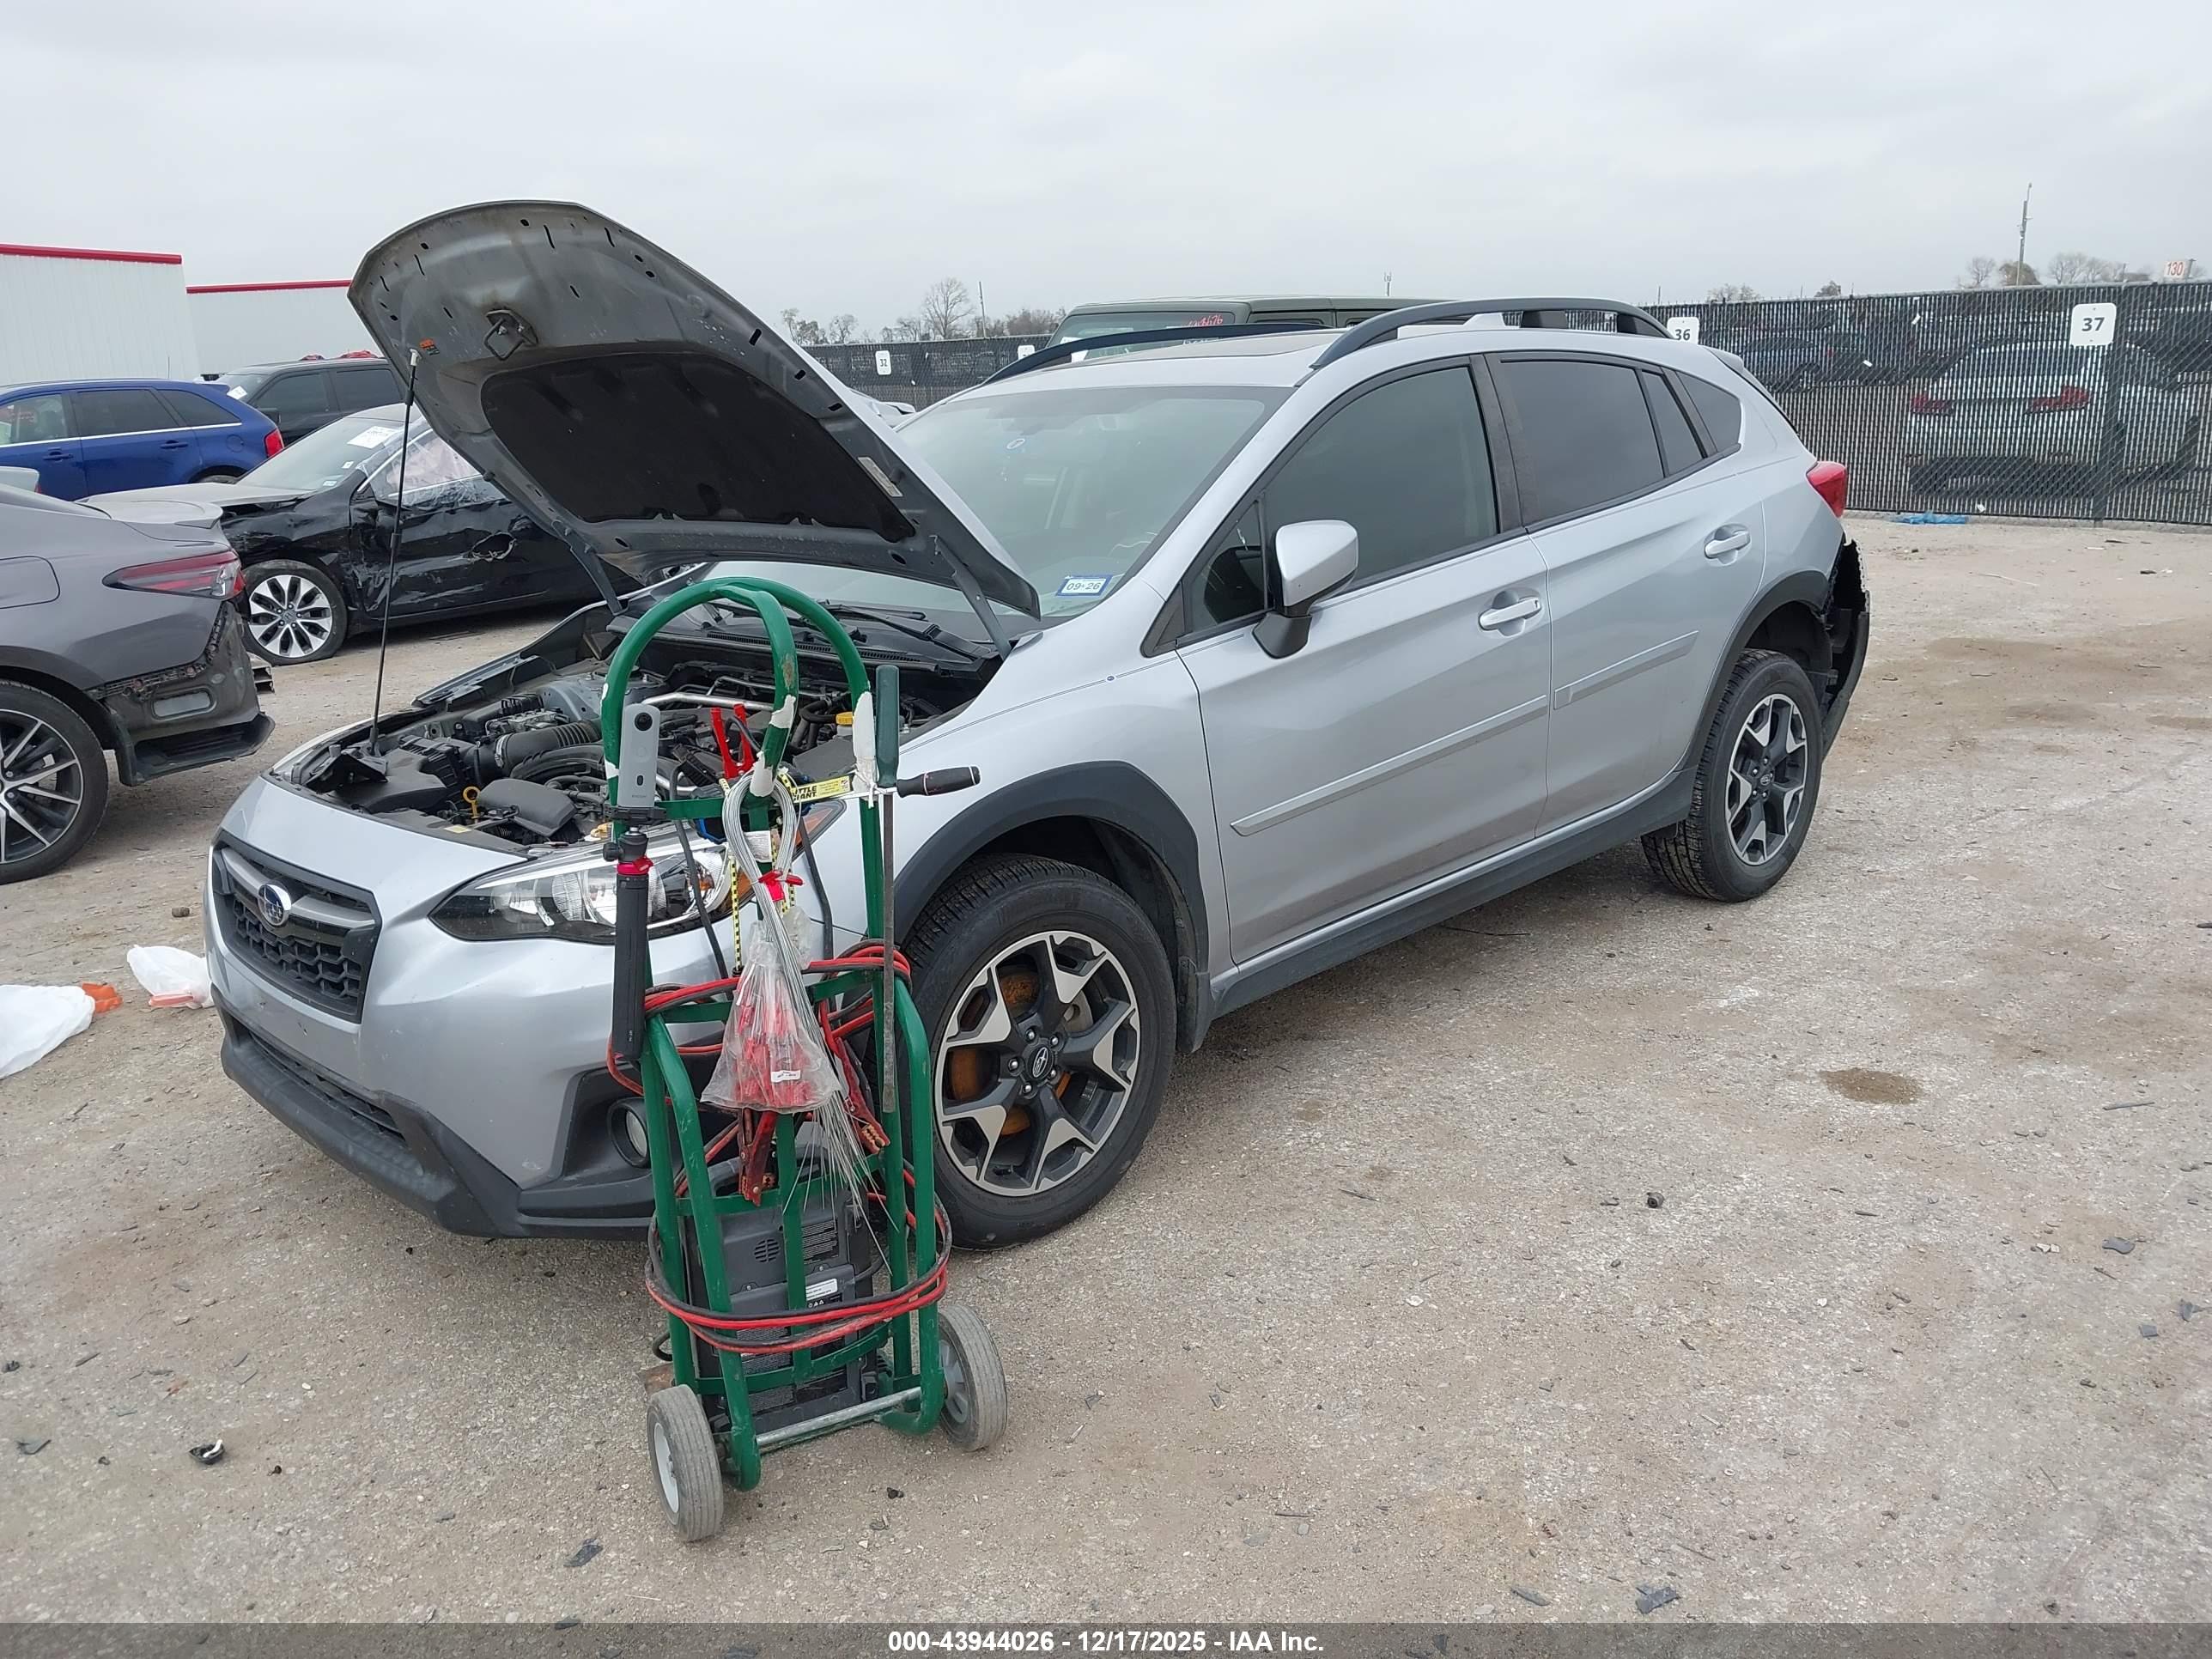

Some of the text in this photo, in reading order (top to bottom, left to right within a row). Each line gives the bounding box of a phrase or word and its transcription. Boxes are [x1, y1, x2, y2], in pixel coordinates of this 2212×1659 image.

[2167, 261, 2184, 276] 130
[2081, 317, 2105, 331] 37
[1674, 328, 1691, 341] 36
[879, 358, 888, 367] 32
[794, 785, 817, 795] ITTLE
